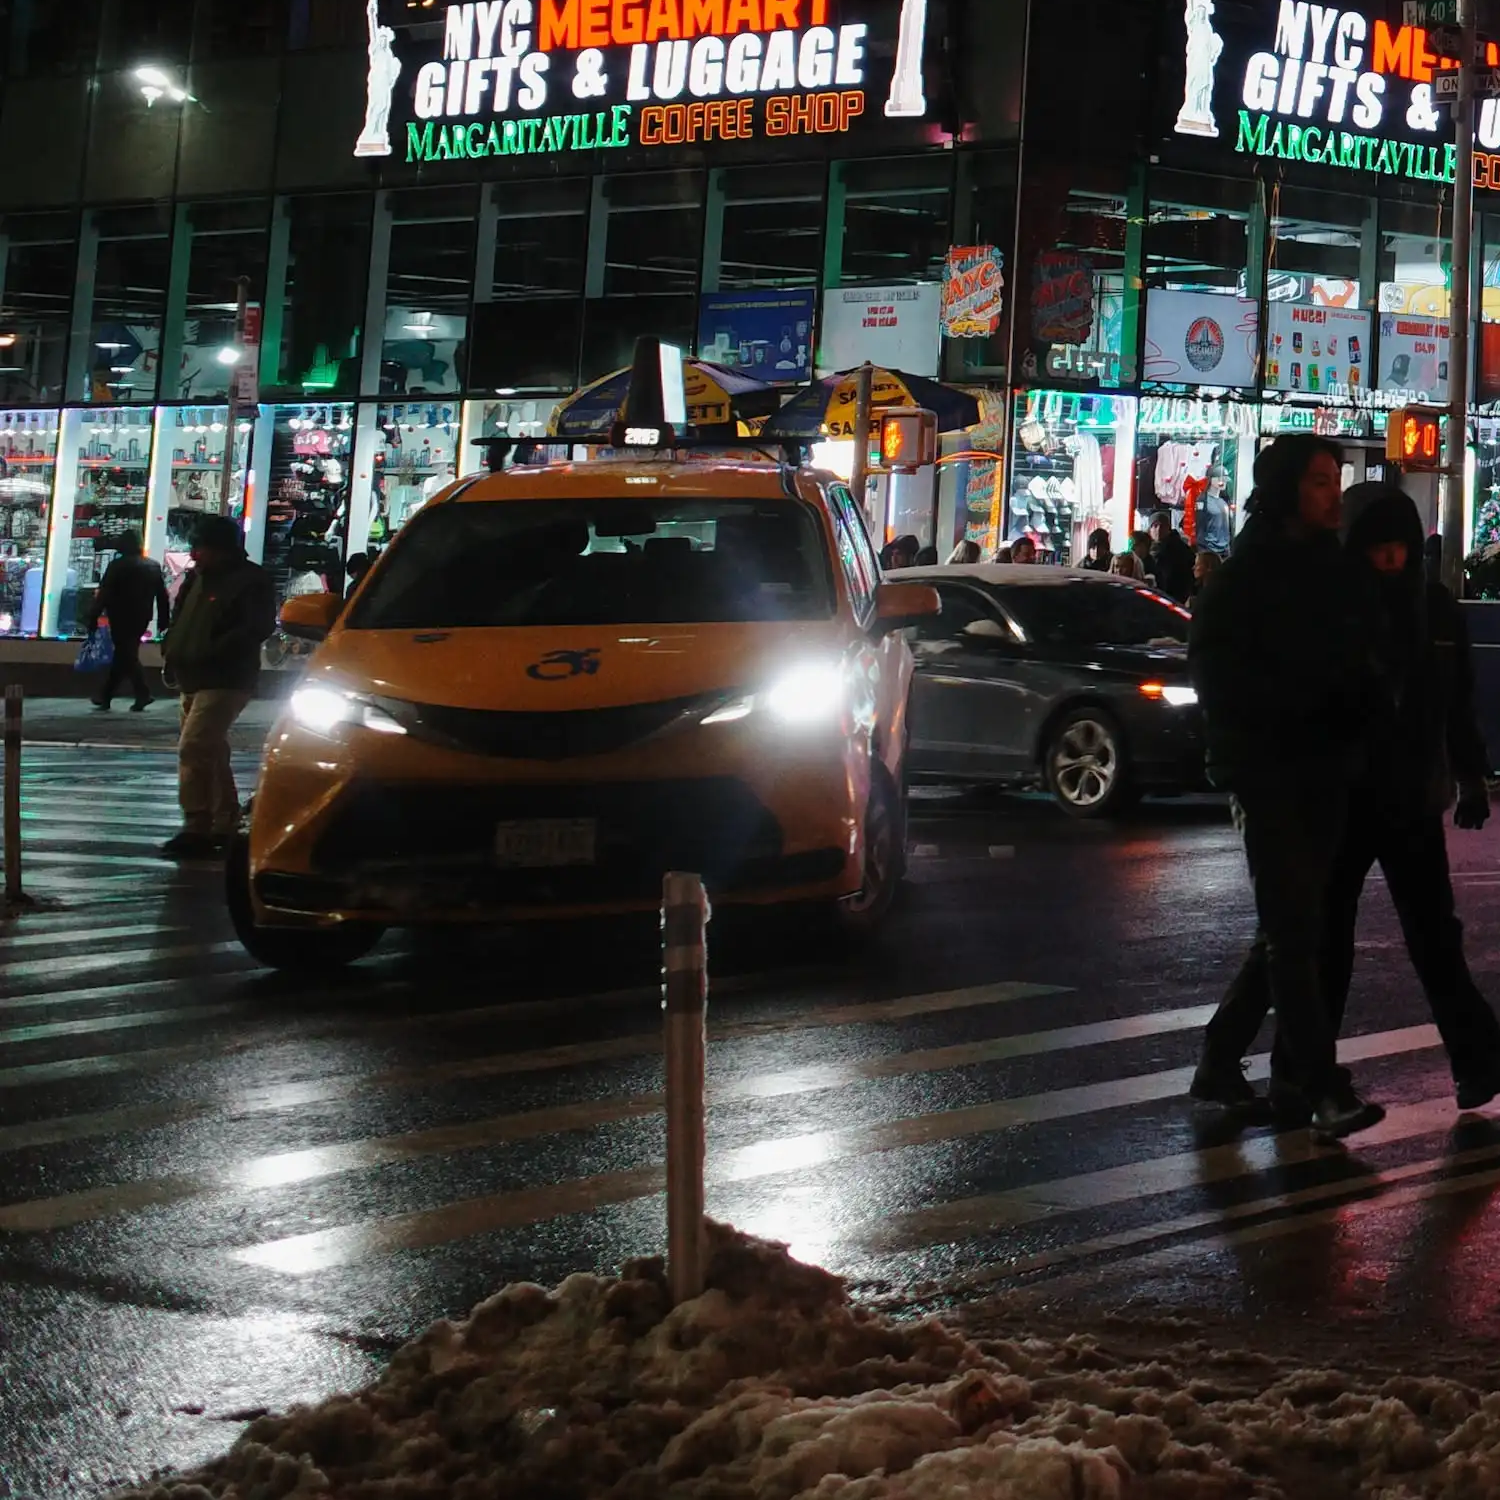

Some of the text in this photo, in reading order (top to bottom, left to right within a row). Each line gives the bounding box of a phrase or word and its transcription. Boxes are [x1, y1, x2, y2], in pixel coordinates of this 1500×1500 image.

[1431, 1, 1445, 21] 40
[414, 23, 868, 119] GIFTS & LUGGAGE
[1243, 52, 1386, 130] GIFTS
[1406, 82, 1440, 132] &
[1442, 79, 1458, 92] ON
[404, 90, 865, 163] MARGARITAVILLE COFFEE SHOP
[1235, 110, 1456, 185] MARGARITAVILLE
[950, 262, 996, 302] NYC
